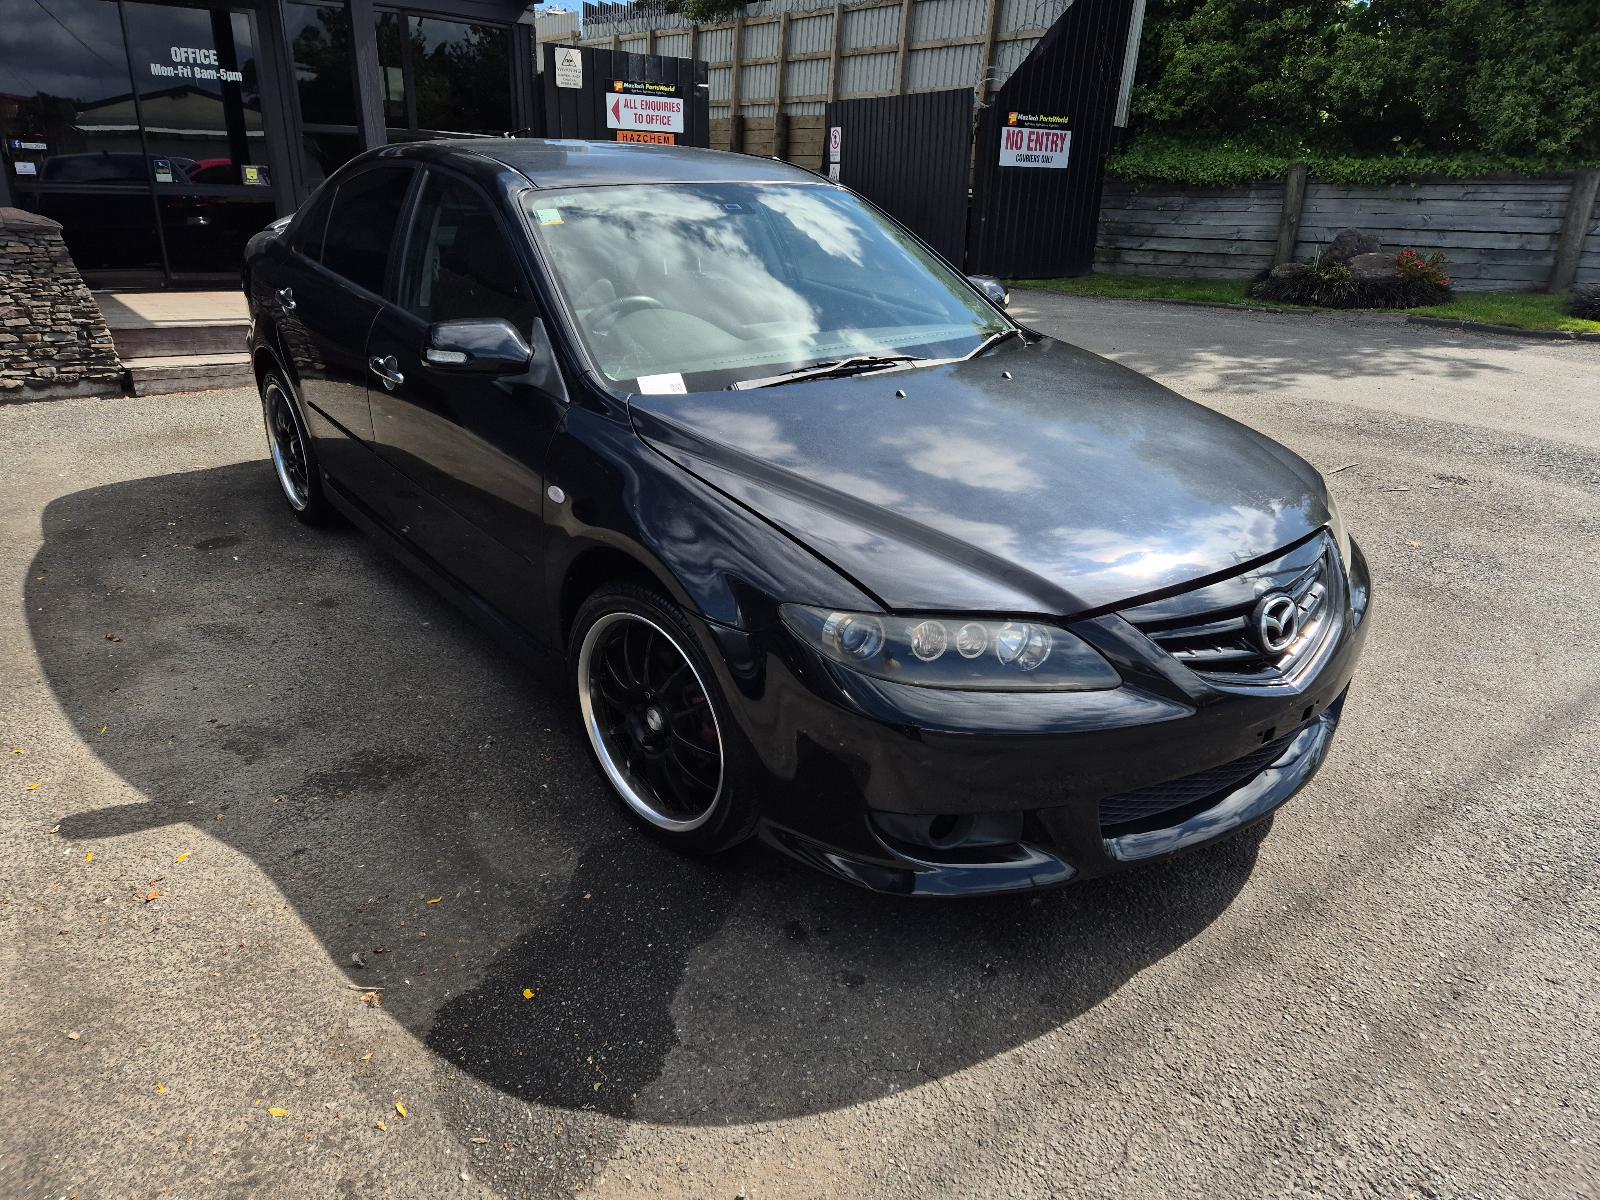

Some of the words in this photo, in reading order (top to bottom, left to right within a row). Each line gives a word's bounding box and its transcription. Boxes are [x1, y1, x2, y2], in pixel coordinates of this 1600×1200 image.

[170, 46, 219, 66] OFFICE
[150, 63, 192, 78] Mon-Fri
[193, 66, 243, 82] 8am-5pm
[623, 98, 638, 110] ALL
[640, 99, 681, 113] ENQUIRIES
[633, 112, 644, 124] TO
[645, 113, 672, 126] OFFICE
[621, 133, 670, 144] HAZCHEM
[1004, 129, 1024, 151] NO
[1026, 130, 1068, 153] ENTRY
